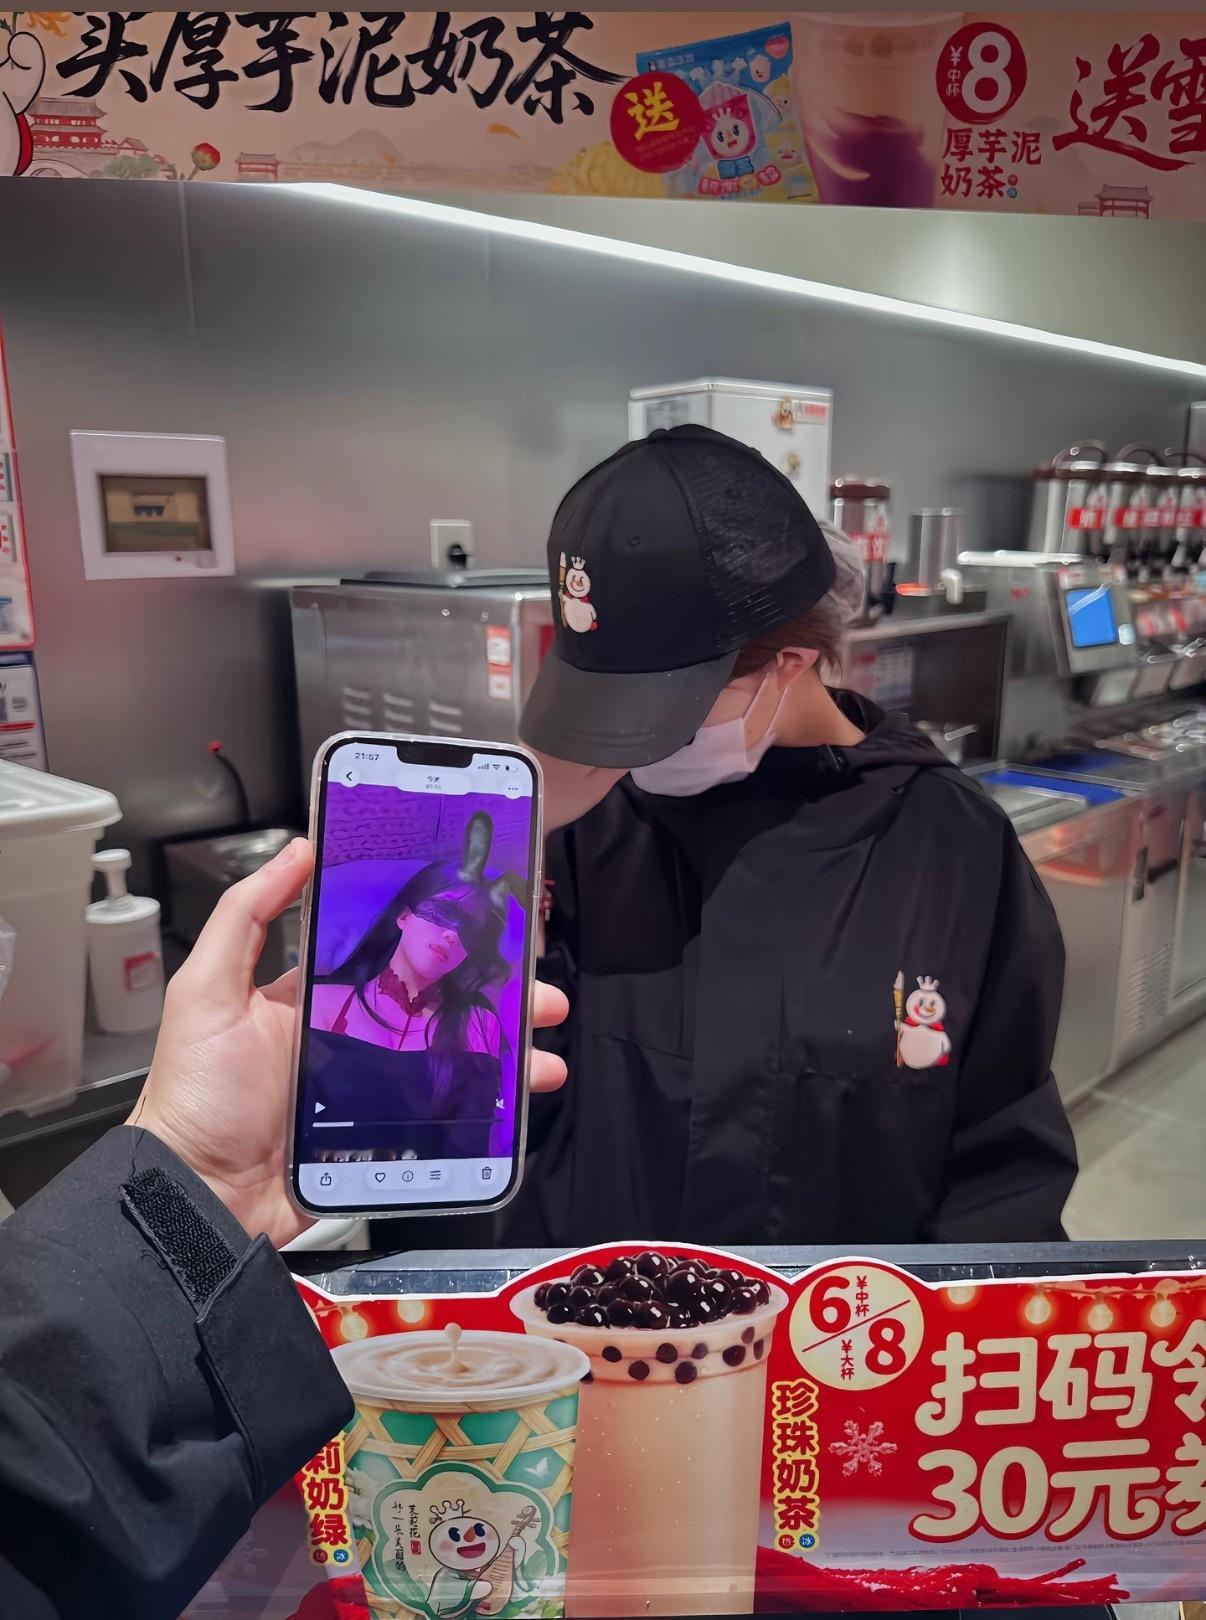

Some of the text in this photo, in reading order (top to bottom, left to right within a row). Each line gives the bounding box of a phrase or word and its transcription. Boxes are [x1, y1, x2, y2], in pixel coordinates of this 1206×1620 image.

[962, 31, 1012, 114] 8
[624, 81, 679, 141] 送
[942, 127, 1042, 165] 厚芋泥
[940, 164, 1007, 199] 奶茶
[354, 752, 380, 761] 21:57
[809, 1275, 851, 1333] 6
[864, 1318, 907, 1376] 8
[775, 1383, 818, 1530] 珍珠奶茶
